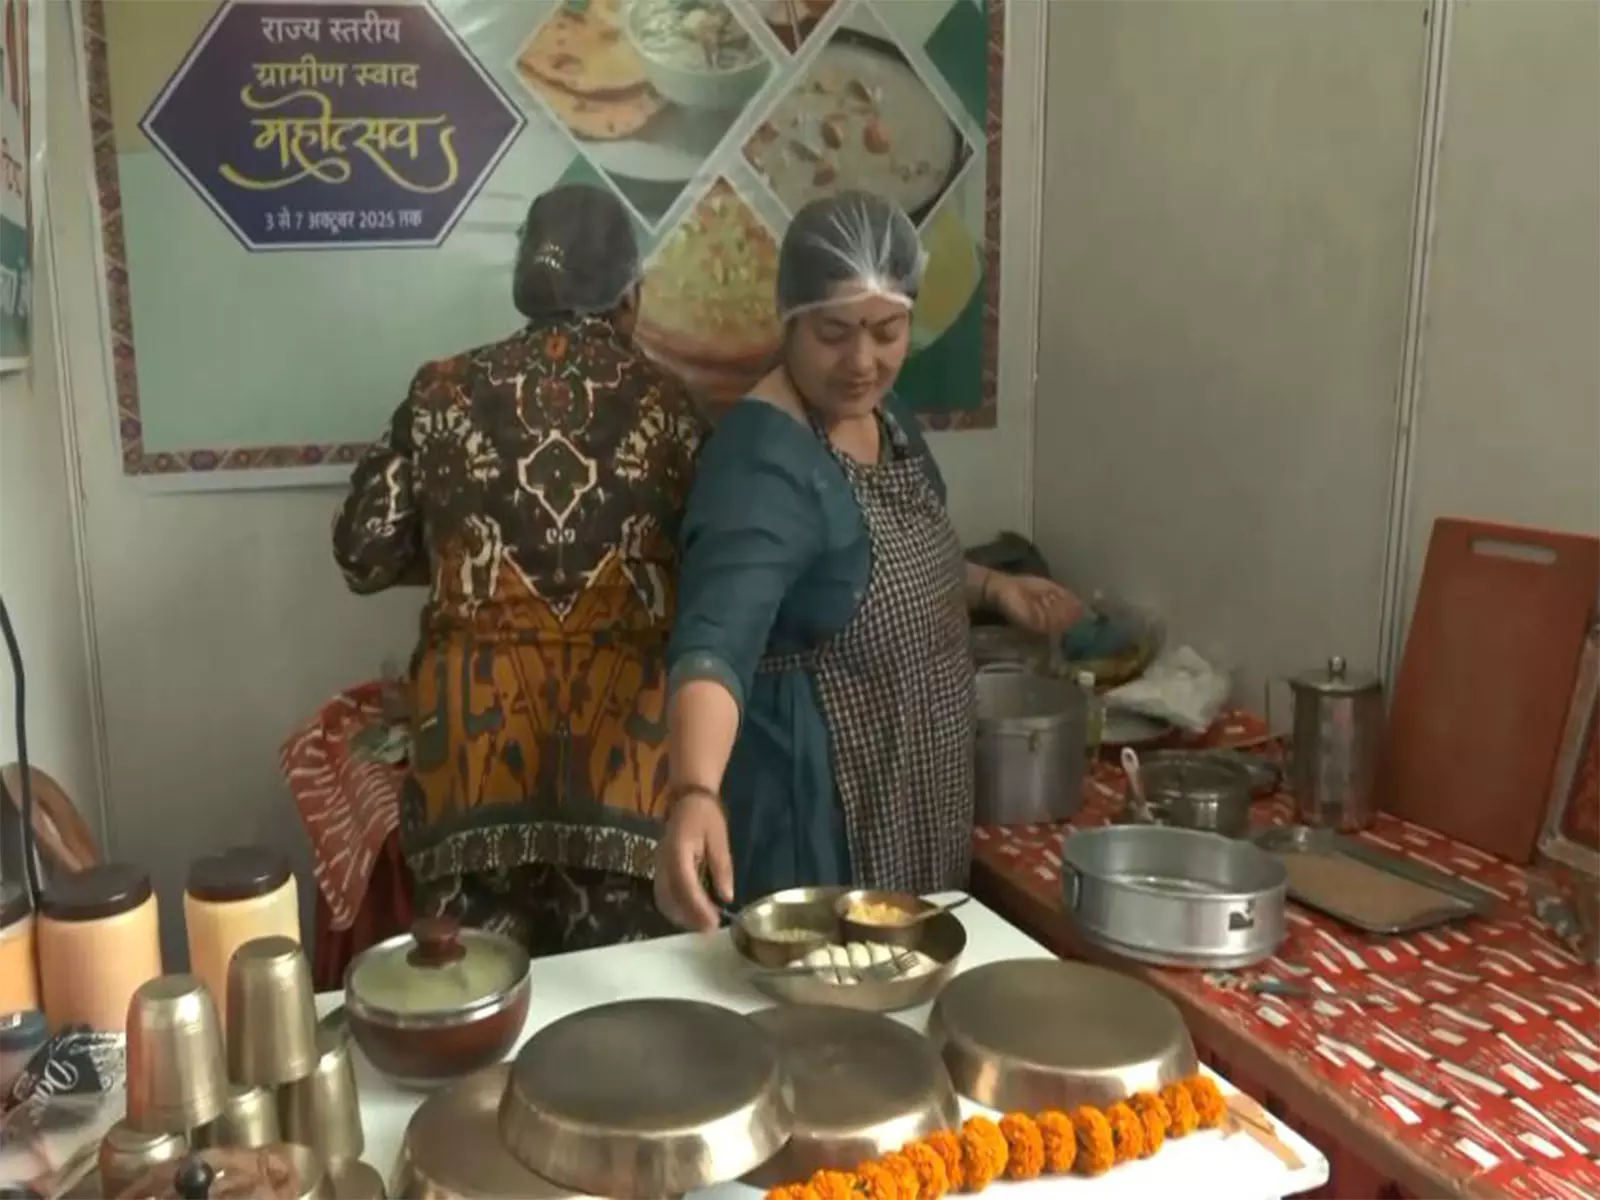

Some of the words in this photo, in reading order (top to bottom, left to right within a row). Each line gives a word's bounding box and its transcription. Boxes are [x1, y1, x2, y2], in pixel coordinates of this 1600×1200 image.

[260, 17, 321, 43] राज्य
[328, 9, 402, 44] स्तरीय
[251, 53, 347, 89] ग्रामीण
[352, 63, 420, 89] स्वाद
[218, 84, 458, 194] महोत्सव
[359, 209, 395, 229] 2025
[398, 208, 422, 228] तक
